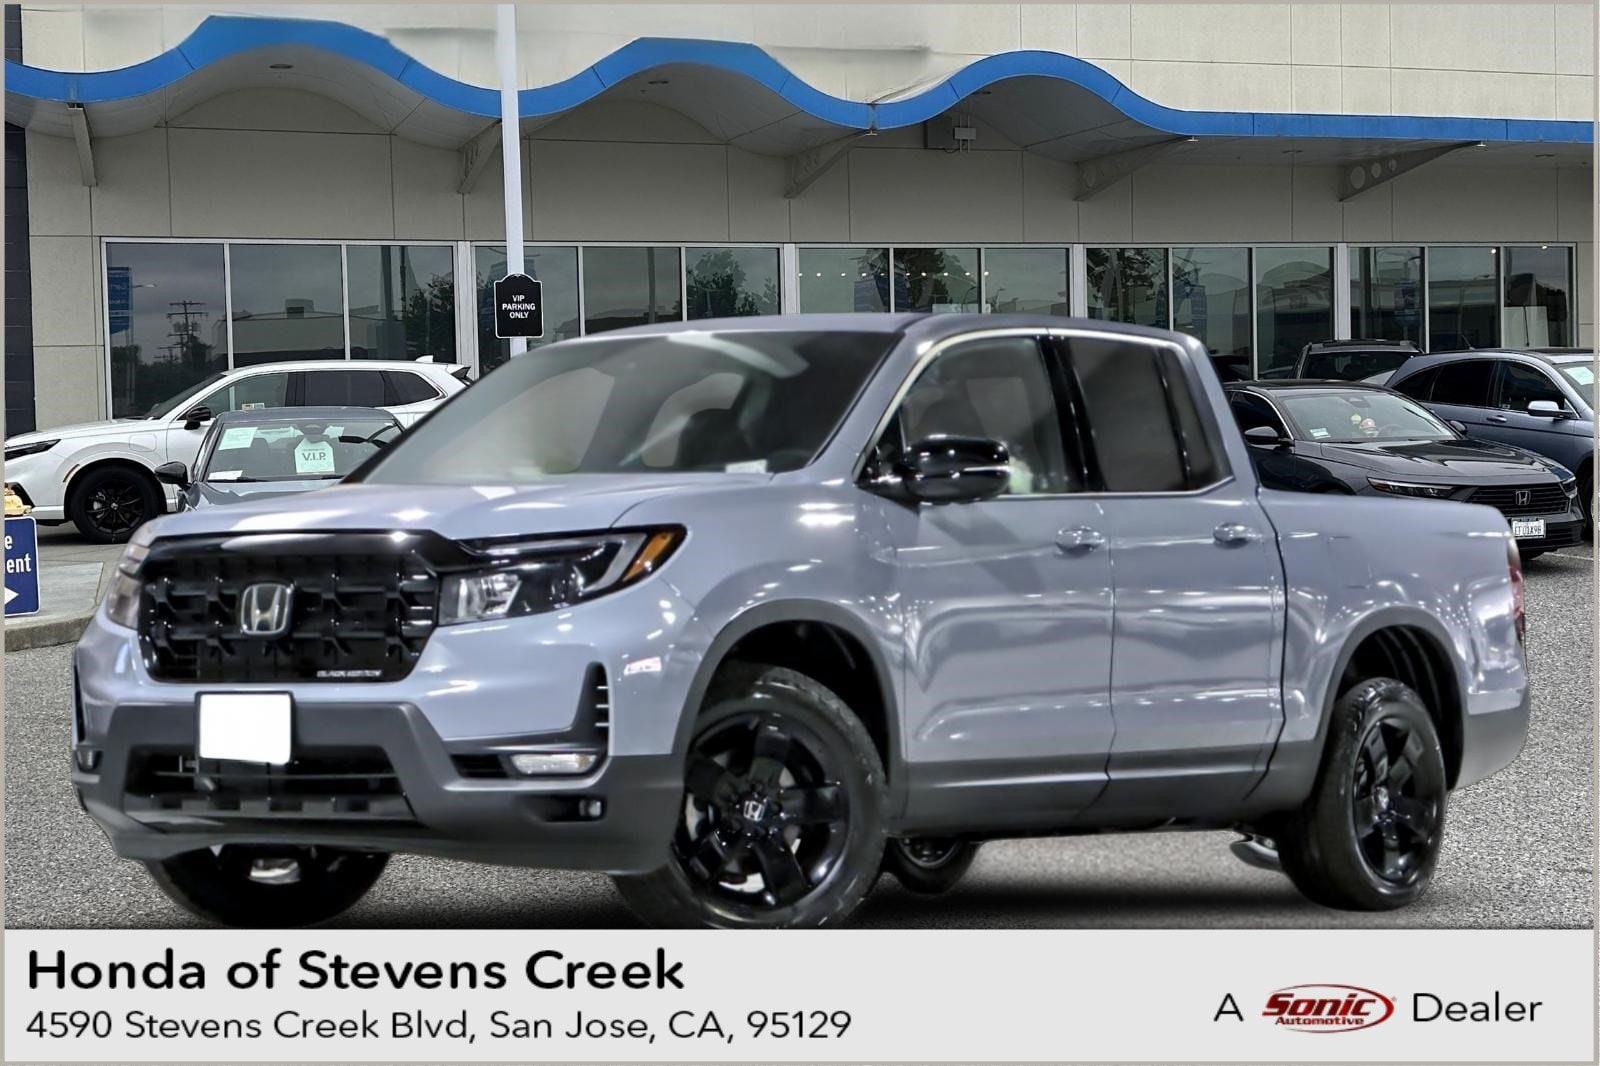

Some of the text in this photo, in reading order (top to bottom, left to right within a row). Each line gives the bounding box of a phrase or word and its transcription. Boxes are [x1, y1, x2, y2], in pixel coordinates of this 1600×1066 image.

[512, 294, 525, 302] VIP
[502, 303, 536, 311] PARKING
[509, 311, 529, 319] ONLY
[6, 553, 32, 574] ent
